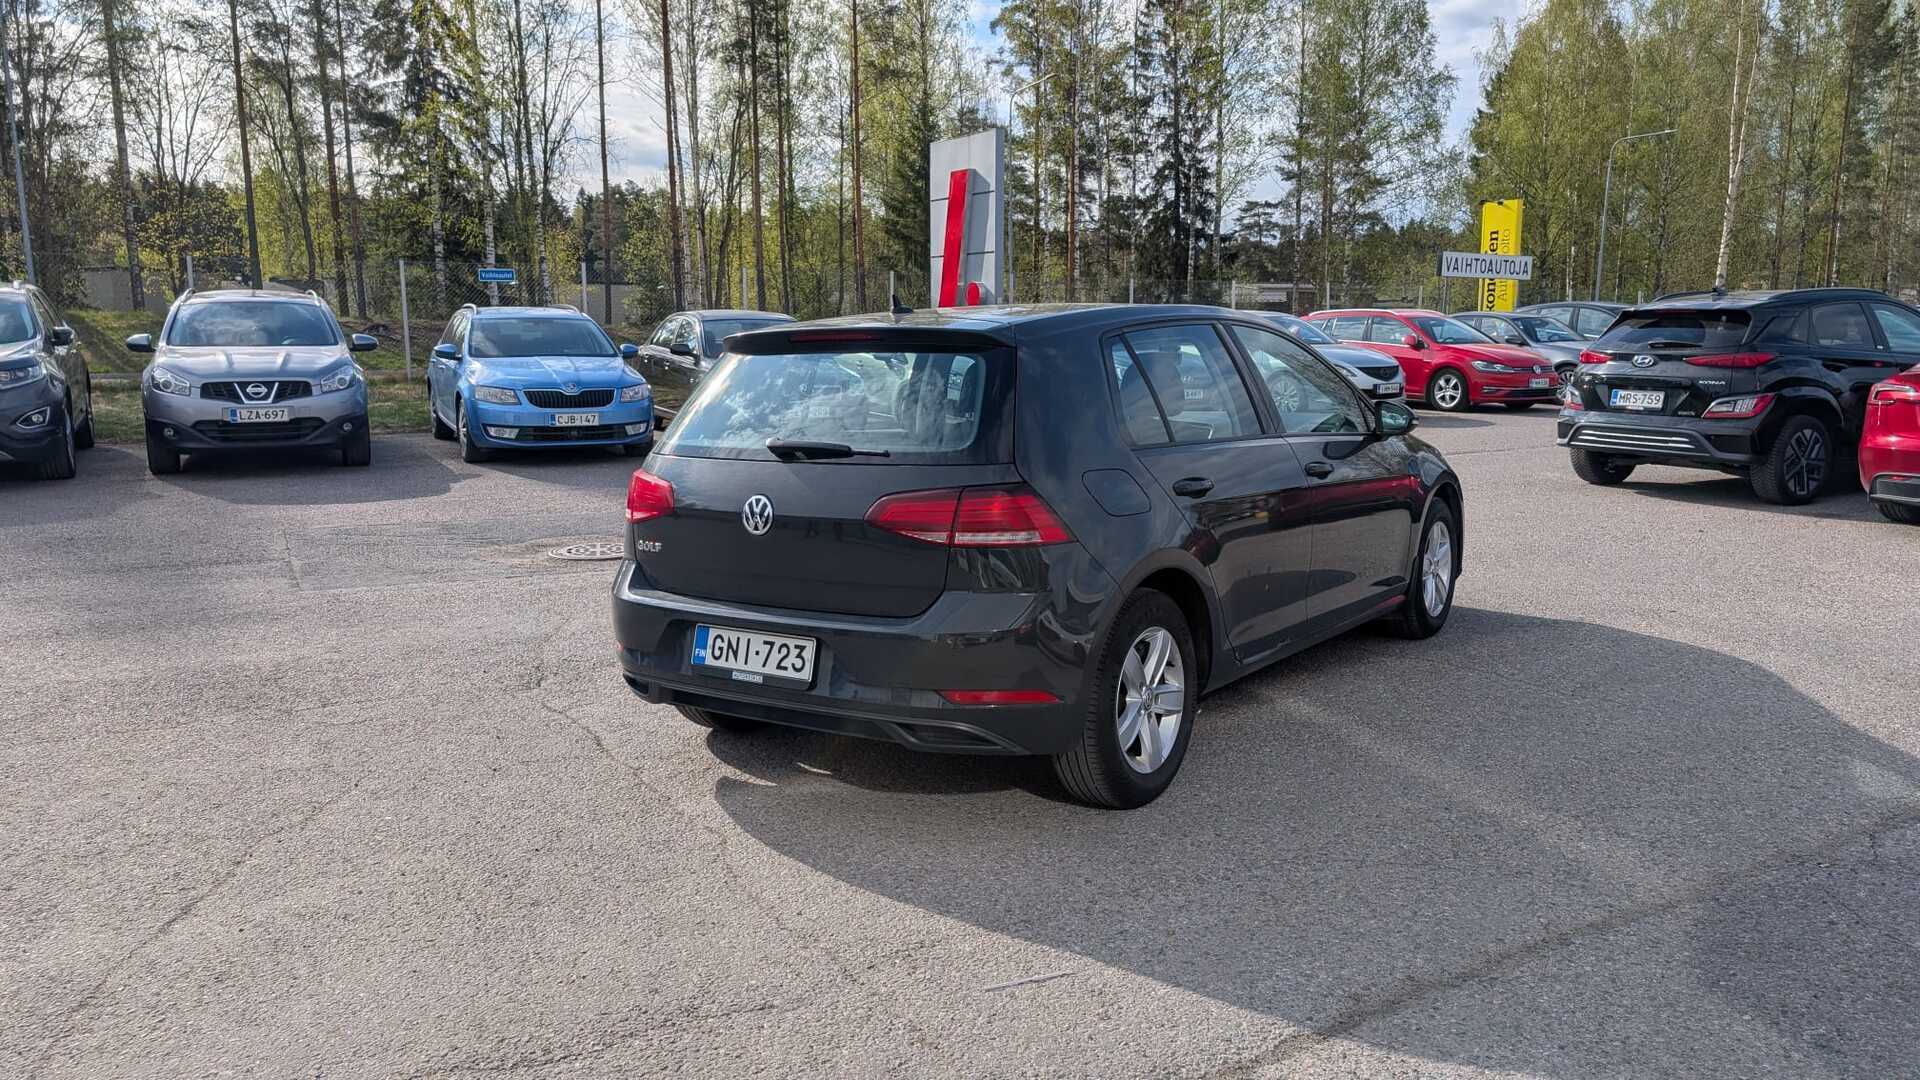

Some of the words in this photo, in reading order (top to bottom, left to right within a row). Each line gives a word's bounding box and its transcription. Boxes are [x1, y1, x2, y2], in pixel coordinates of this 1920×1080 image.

[1445, 256, 1529, 276] VAIHTOAUTOJA
[1618, 392, 1661, 405] MRS-759
[239, 409, 286, 420] LZA-697
[557, 415, 596, 425] CJB-147
[637, 540, 662, 553] GOLF
[695, 648, 706, 658] FIN
[711, 633, 807, 673] GNI-723
